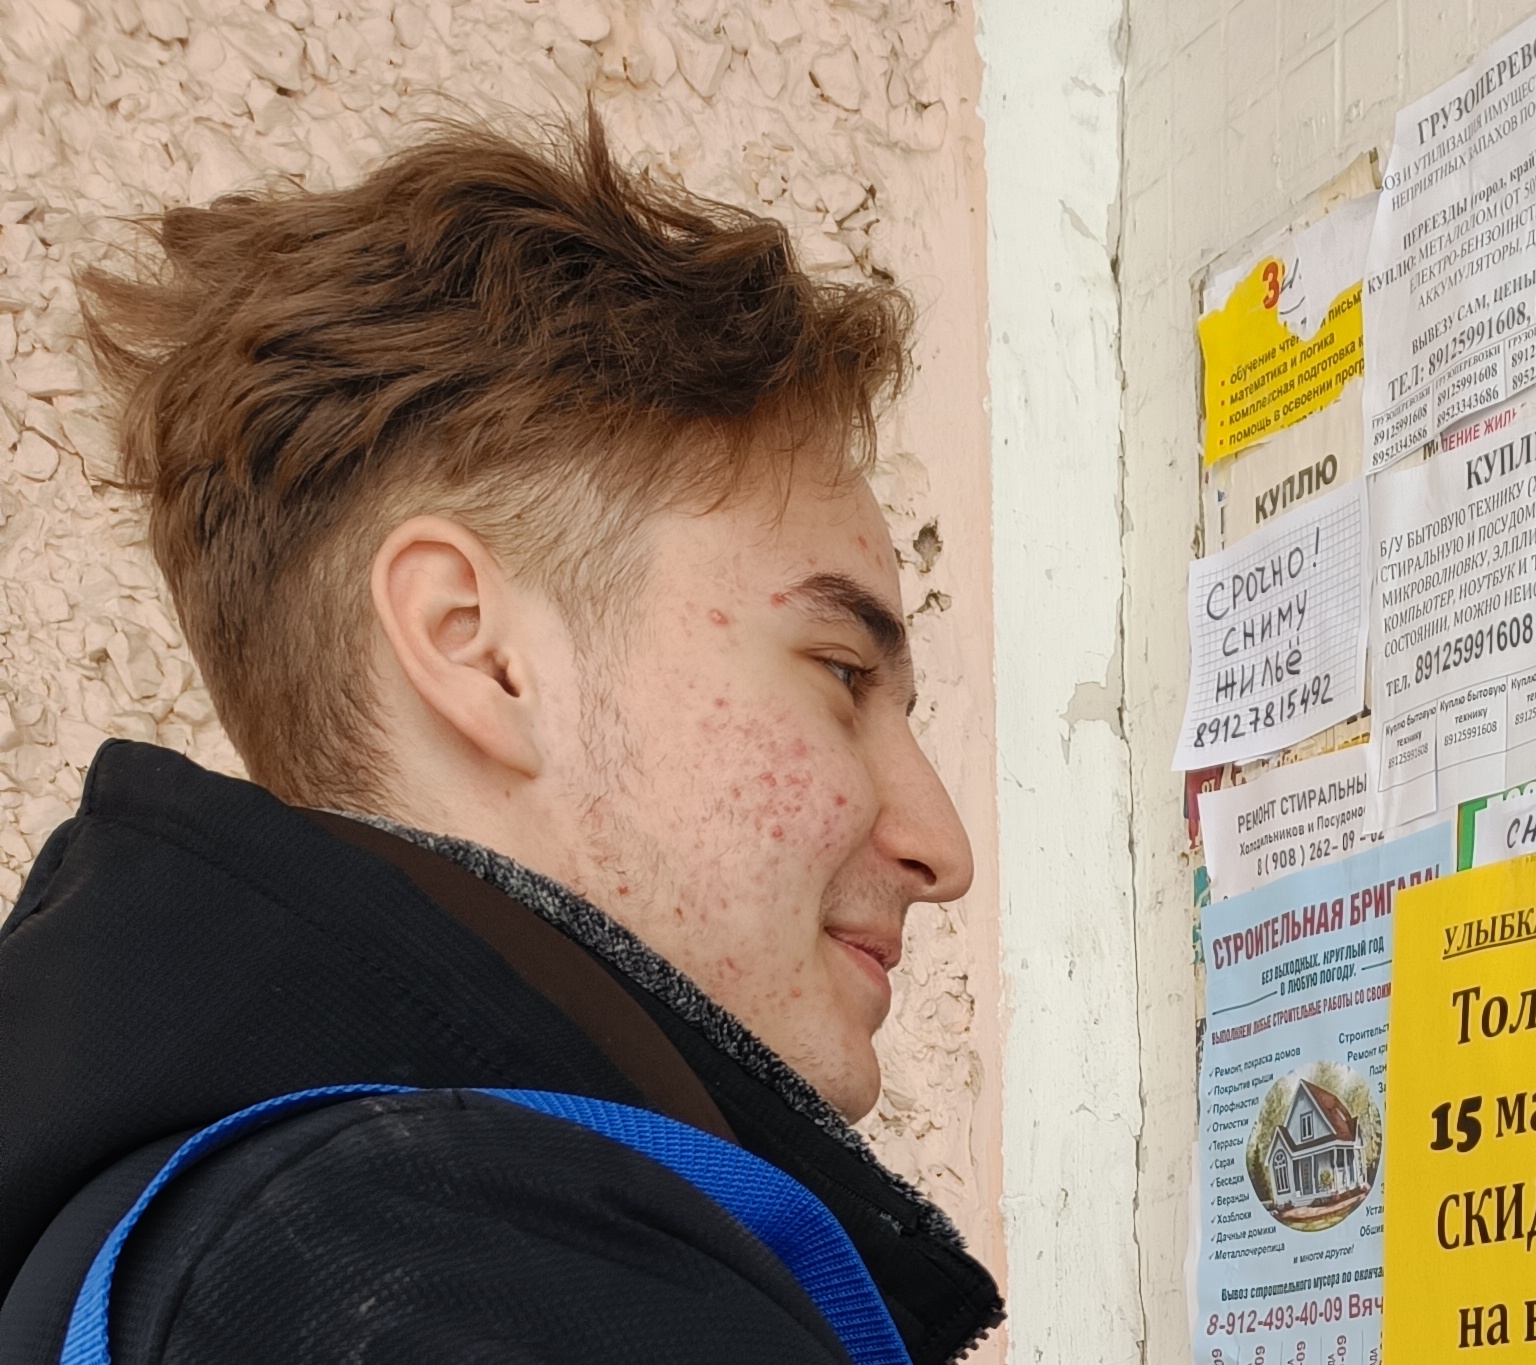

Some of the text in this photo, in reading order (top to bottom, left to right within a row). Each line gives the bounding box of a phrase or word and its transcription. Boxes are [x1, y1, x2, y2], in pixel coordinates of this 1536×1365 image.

[1412, 317, 1453, 355] ВЫВЕЗУ
[1457, 295, 1490, 327] САМ,
[1493, 270, 1535, 303] ЦЕНЫ
[1229, 363, 1288, 405] математика
[1299, 332, 1335, 363] логика
[1388, 365, 1424, 402] ТЕЛ:
[1428, 301, 1532, 377] 89125991608,
[1254, 455, 1338, 523] КУПЛЮ
[1379, 535, 1403, 557] Б/У
[1407, 510, 1466, 549] БЫТОВУЮ
[1467, 481, 1524, 520] ТЕХНИКУ
[1386, 673, 1410, 697] ТЕЛ.
[1415, 613, 1533, 684] 89125991608
[1238, 800, 1277, 833] РЕМОНТ
[1212, 898, 1344, 970] СТРОИТЕЛЬНАЯ
[1431, 1095, 1483, 1152] 15
[1207, 1296, 1342, 1336] 8-912-493-40-09
[1458, 1304, 1508, 1348] на
